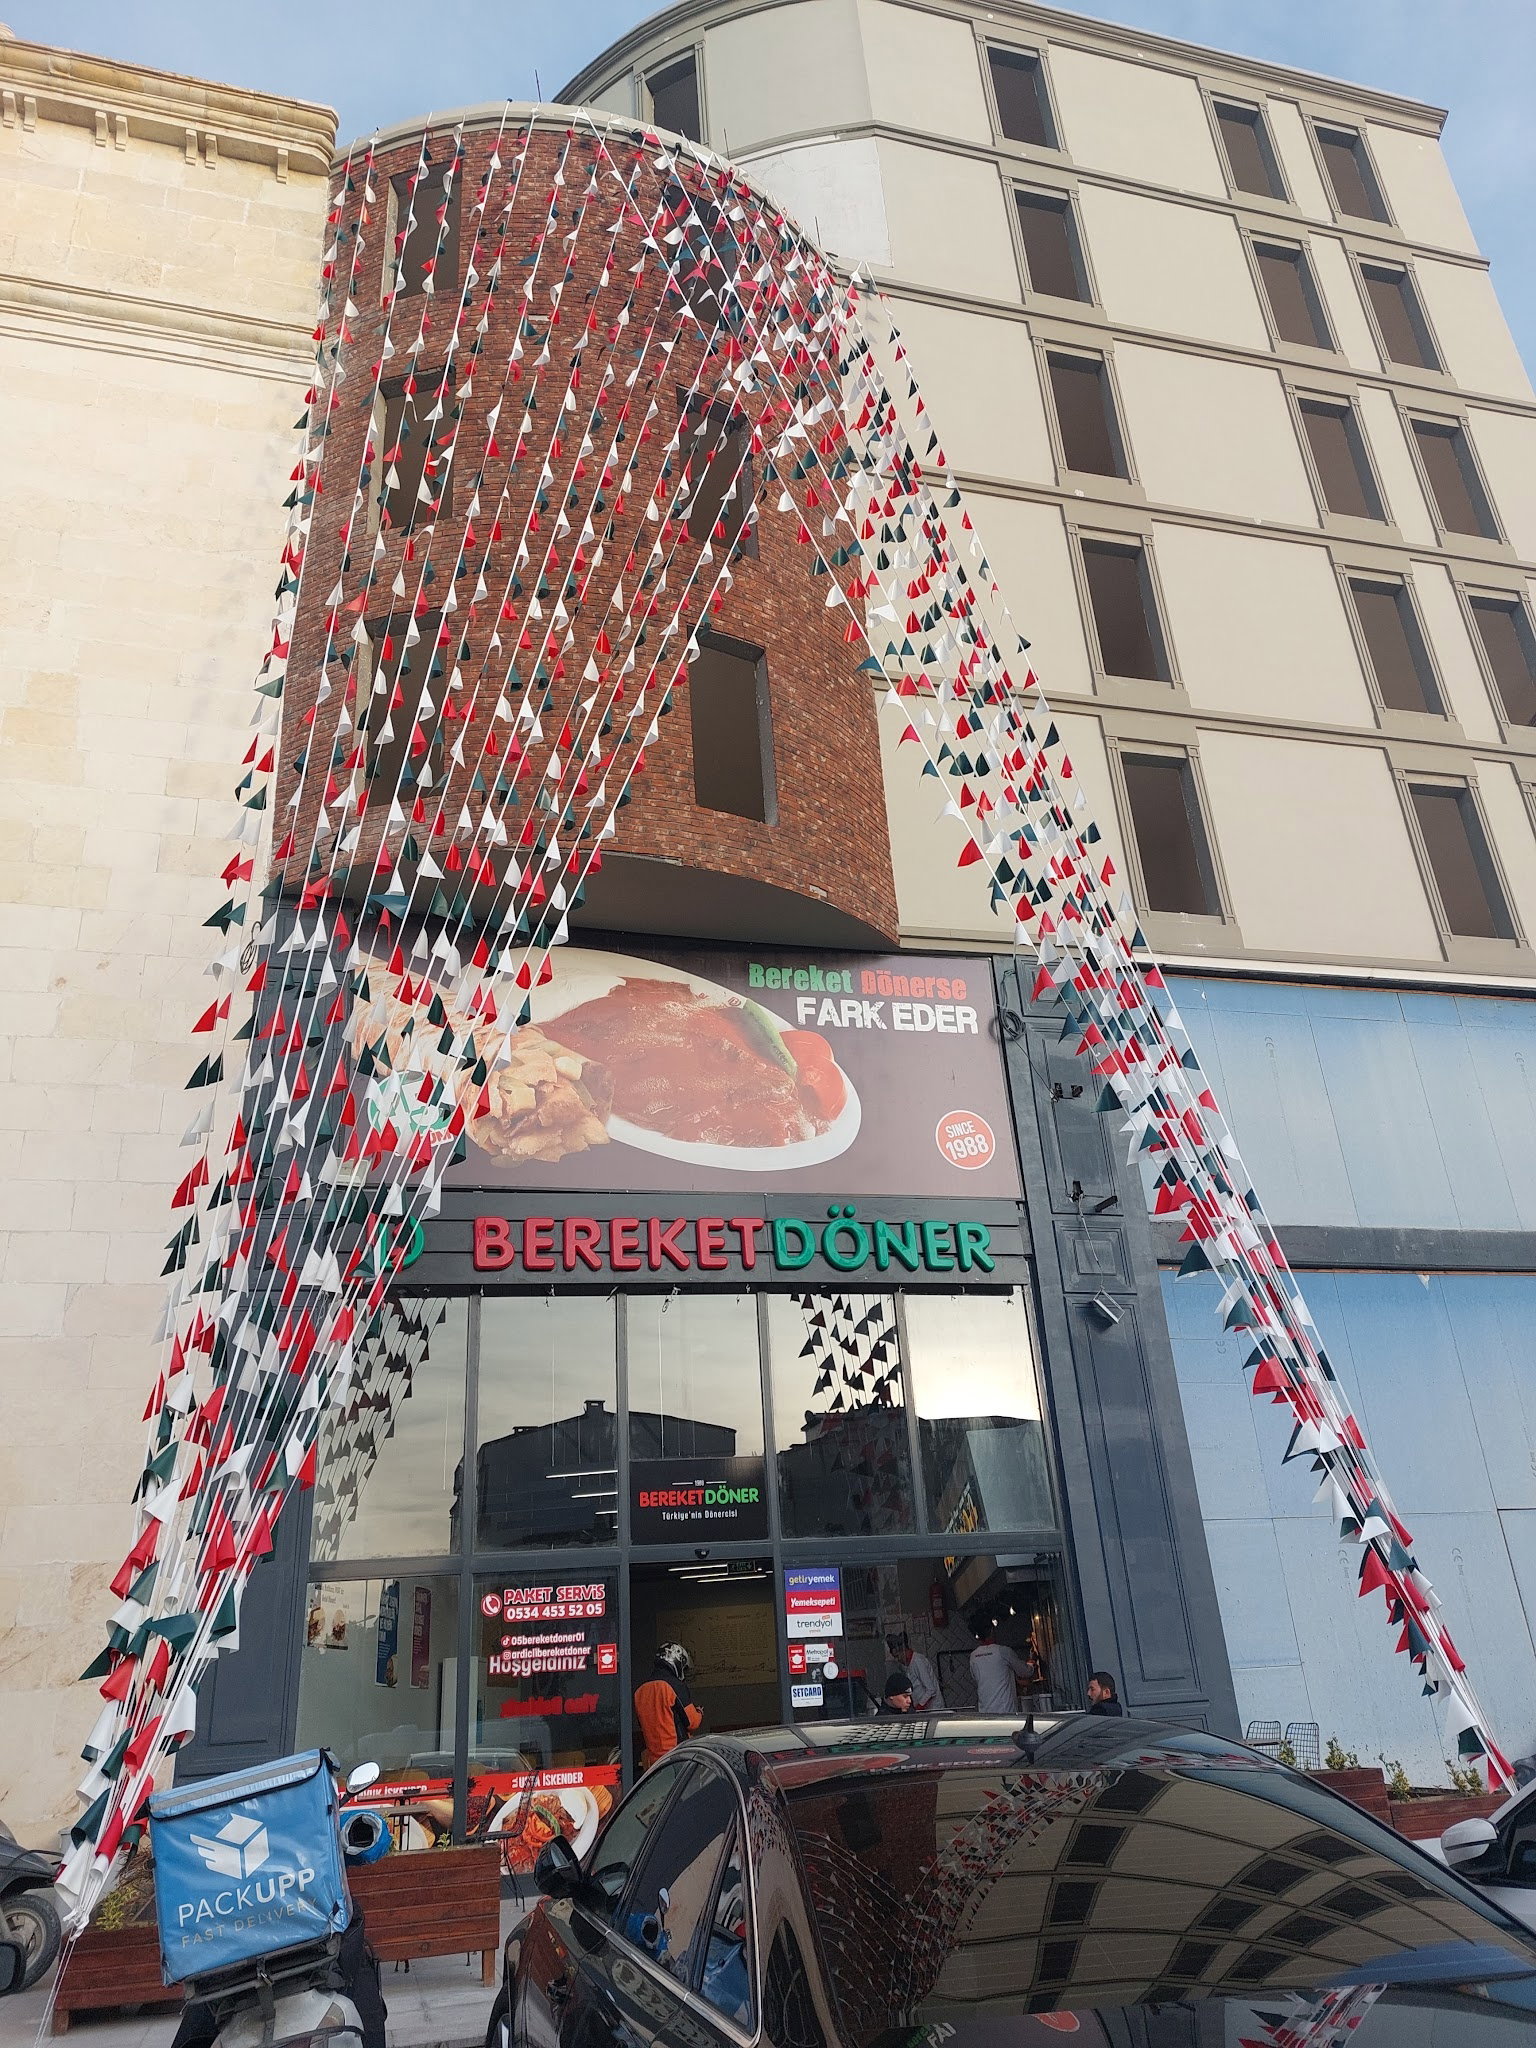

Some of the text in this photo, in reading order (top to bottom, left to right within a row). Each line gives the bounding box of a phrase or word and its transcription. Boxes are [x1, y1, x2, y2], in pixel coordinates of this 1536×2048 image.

[749, 963, 967, 1000] Bereket Dönerse
[796, 996, 979, 1034] FARK EDER
[945, 1120, 977, 1138] SINCE
[945, 1134, 990, 1161] 1988
[788, 1574, 835, 1586] getiryemek
[504, 1587, 553, 1605] PAKET
[790, 1597, 836, 1608] Yemeksepeti
[506, 1603, 603, 1620] 0534 453 52 05
[796, 1617, 833, 1629] trendyol
[511, 1632, 585, 1646] 05bereketdoner01
[792, 1686, 822, 1698] SETCARD
[543, 1771, 584, 1787] İSKENDER
[178, 1867, 316, 1928] PACKUPP
[181, 1922, 226, 1949] FAST
